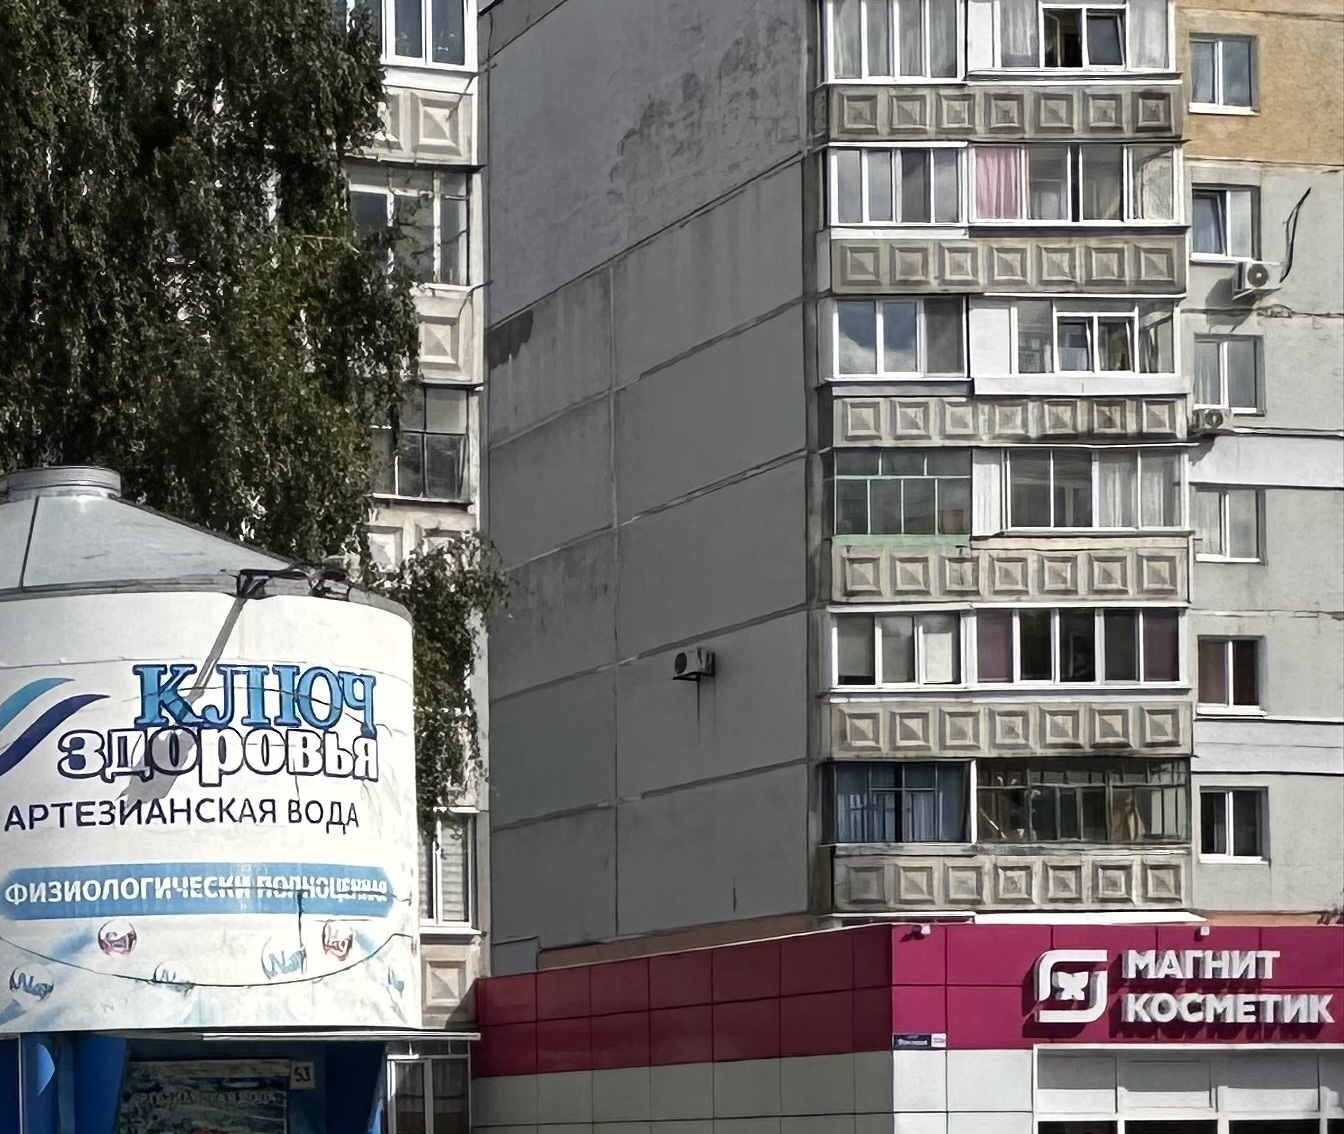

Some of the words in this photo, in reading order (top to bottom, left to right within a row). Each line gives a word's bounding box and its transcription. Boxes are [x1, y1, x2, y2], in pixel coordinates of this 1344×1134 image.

[133, 664, 376, 738] КЛЮЧ
[4, 798, 276, 832] АРТЕЗИАНСКАЯ
[287, 801, 359, 835] ВОДА
[4, 875, 250, 906] ФИЗИОЛОГИЧЕСКИ
[1122, 949, 1281, 979] МАГНИТ
[1122, 993, 1335, 1023] КОСМЕТИК
